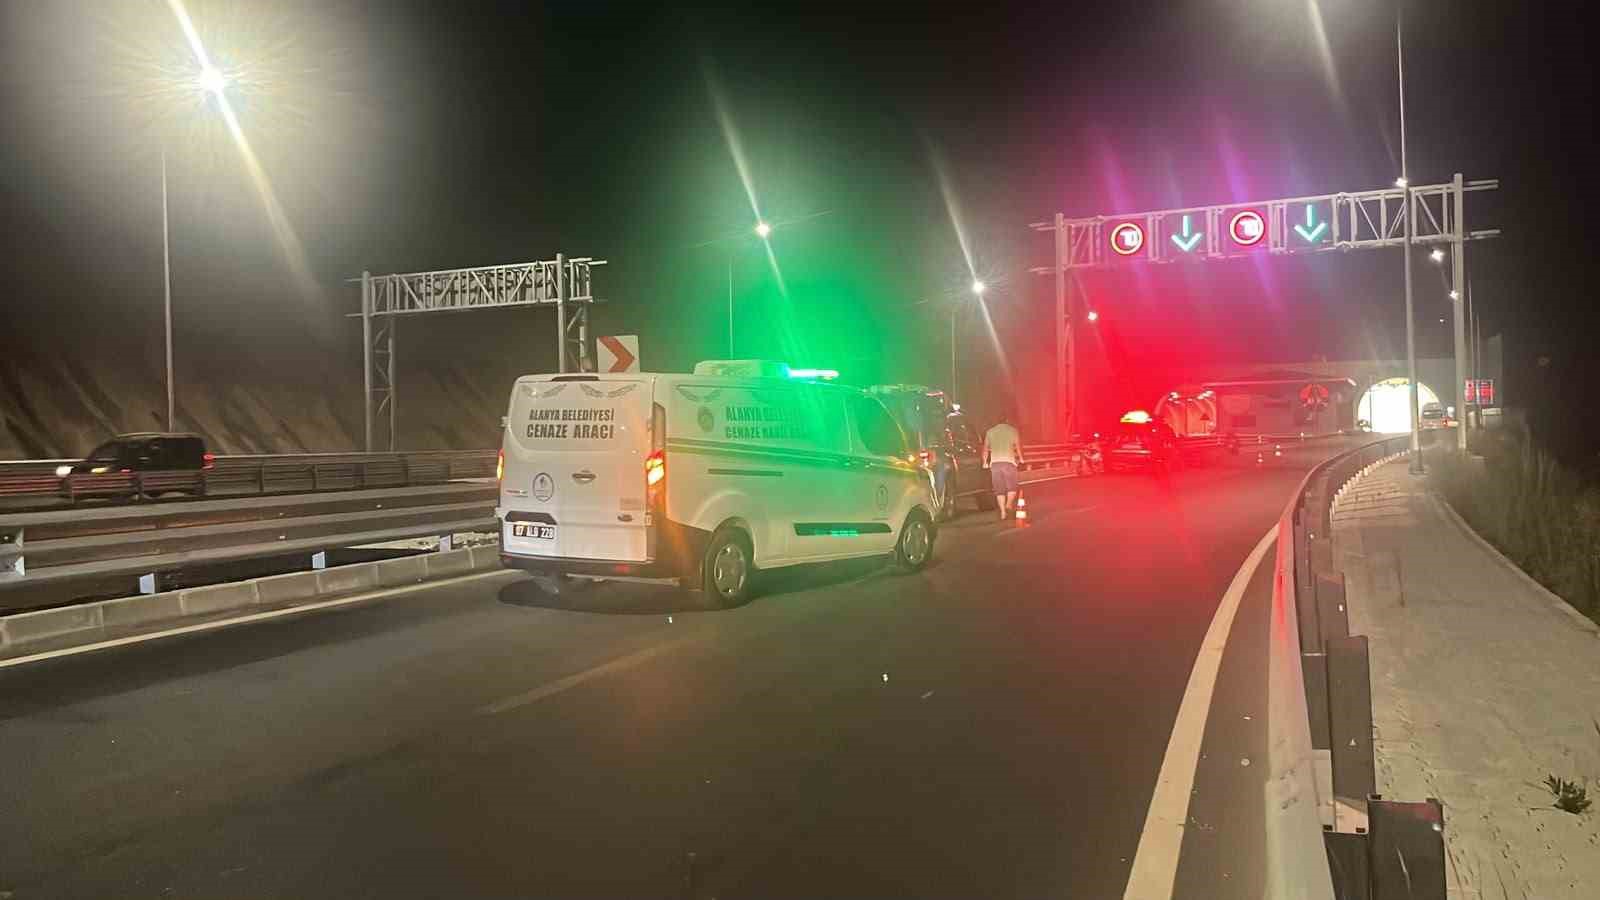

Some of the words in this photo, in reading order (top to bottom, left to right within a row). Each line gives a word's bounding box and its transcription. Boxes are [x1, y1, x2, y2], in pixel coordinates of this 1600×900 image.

[528, 408, 560, 421] ALANYA
[561, 407, 615, 421] BELEDİYESİ
[526, 424, 568, 439] CENAZE
[572, 424, 614, 439] ARACI
[725, 425, 761, 439] CENAZE
